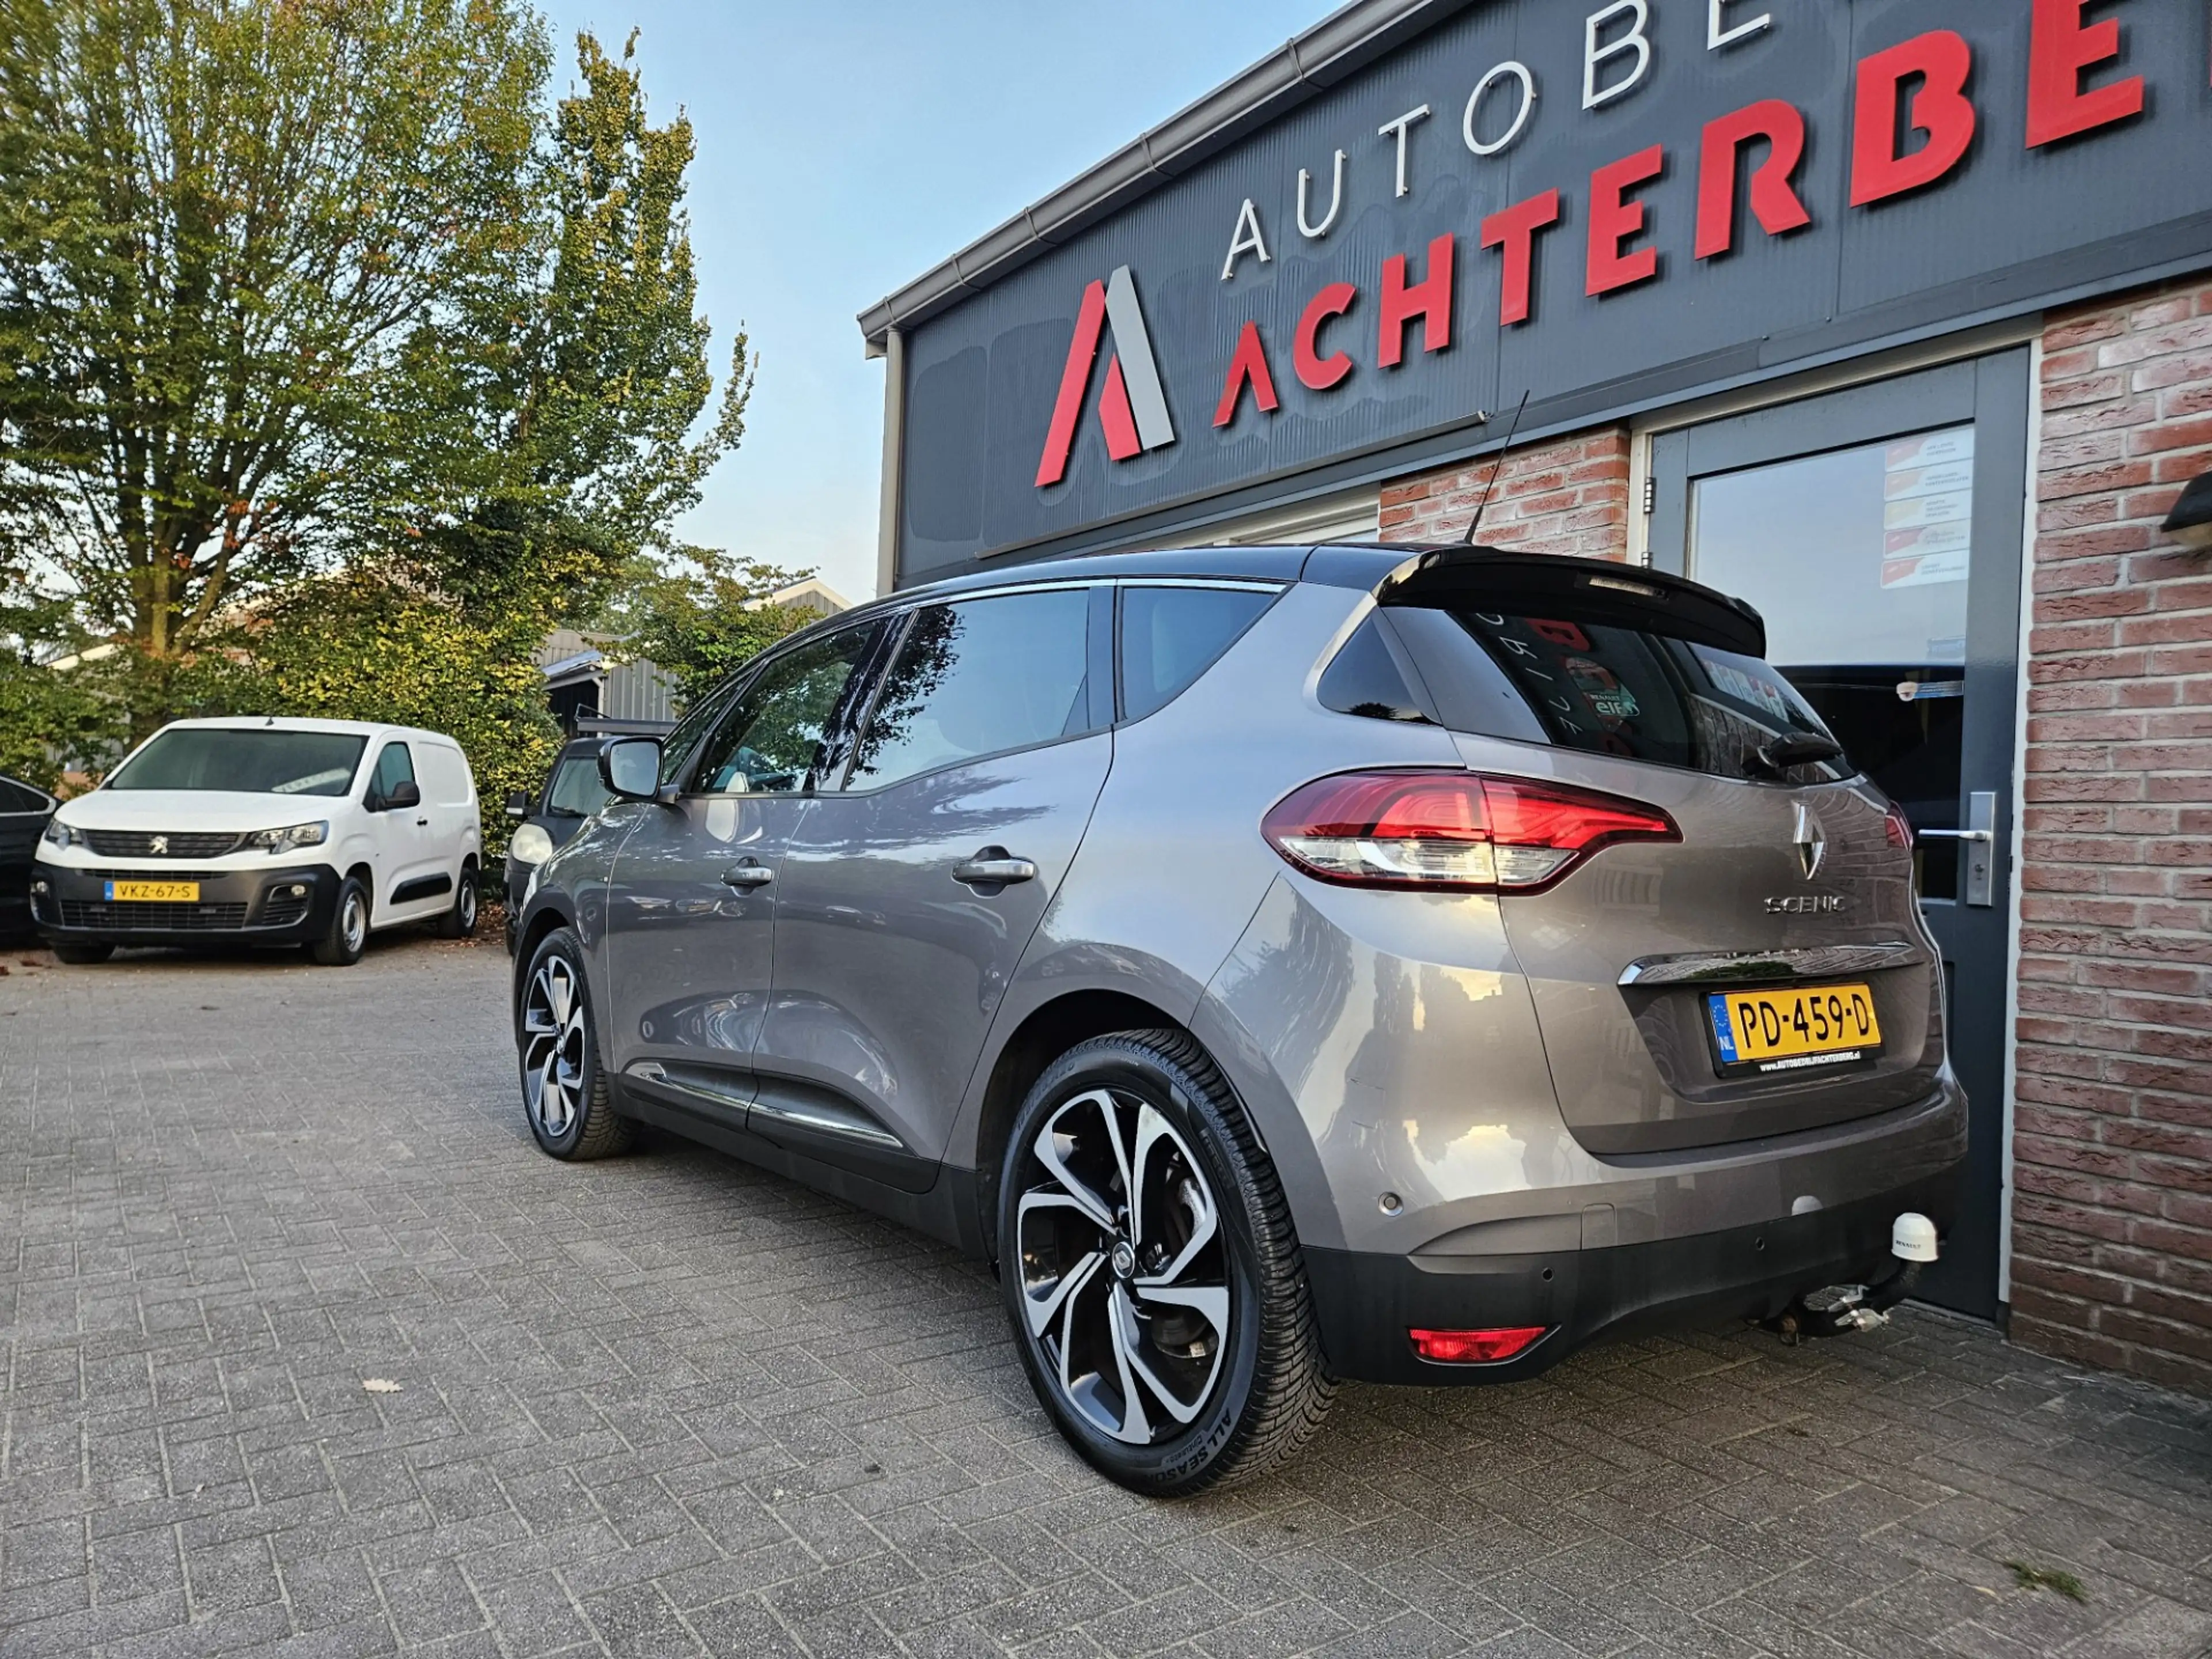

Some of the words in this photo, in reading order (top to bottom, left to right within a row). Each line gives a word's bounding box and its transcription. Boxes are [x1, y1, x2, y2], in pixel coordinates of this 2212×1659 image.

[1213, 0, 2212, 428] ACHTERBE
[119, 885, 191, 898] VKZ-67-S
[1764, 896, 1846, 914] SCENIC
[1738, 993, 1870, 1048] PD-459-D
[1719, 1036, 1734, 1051] NL
